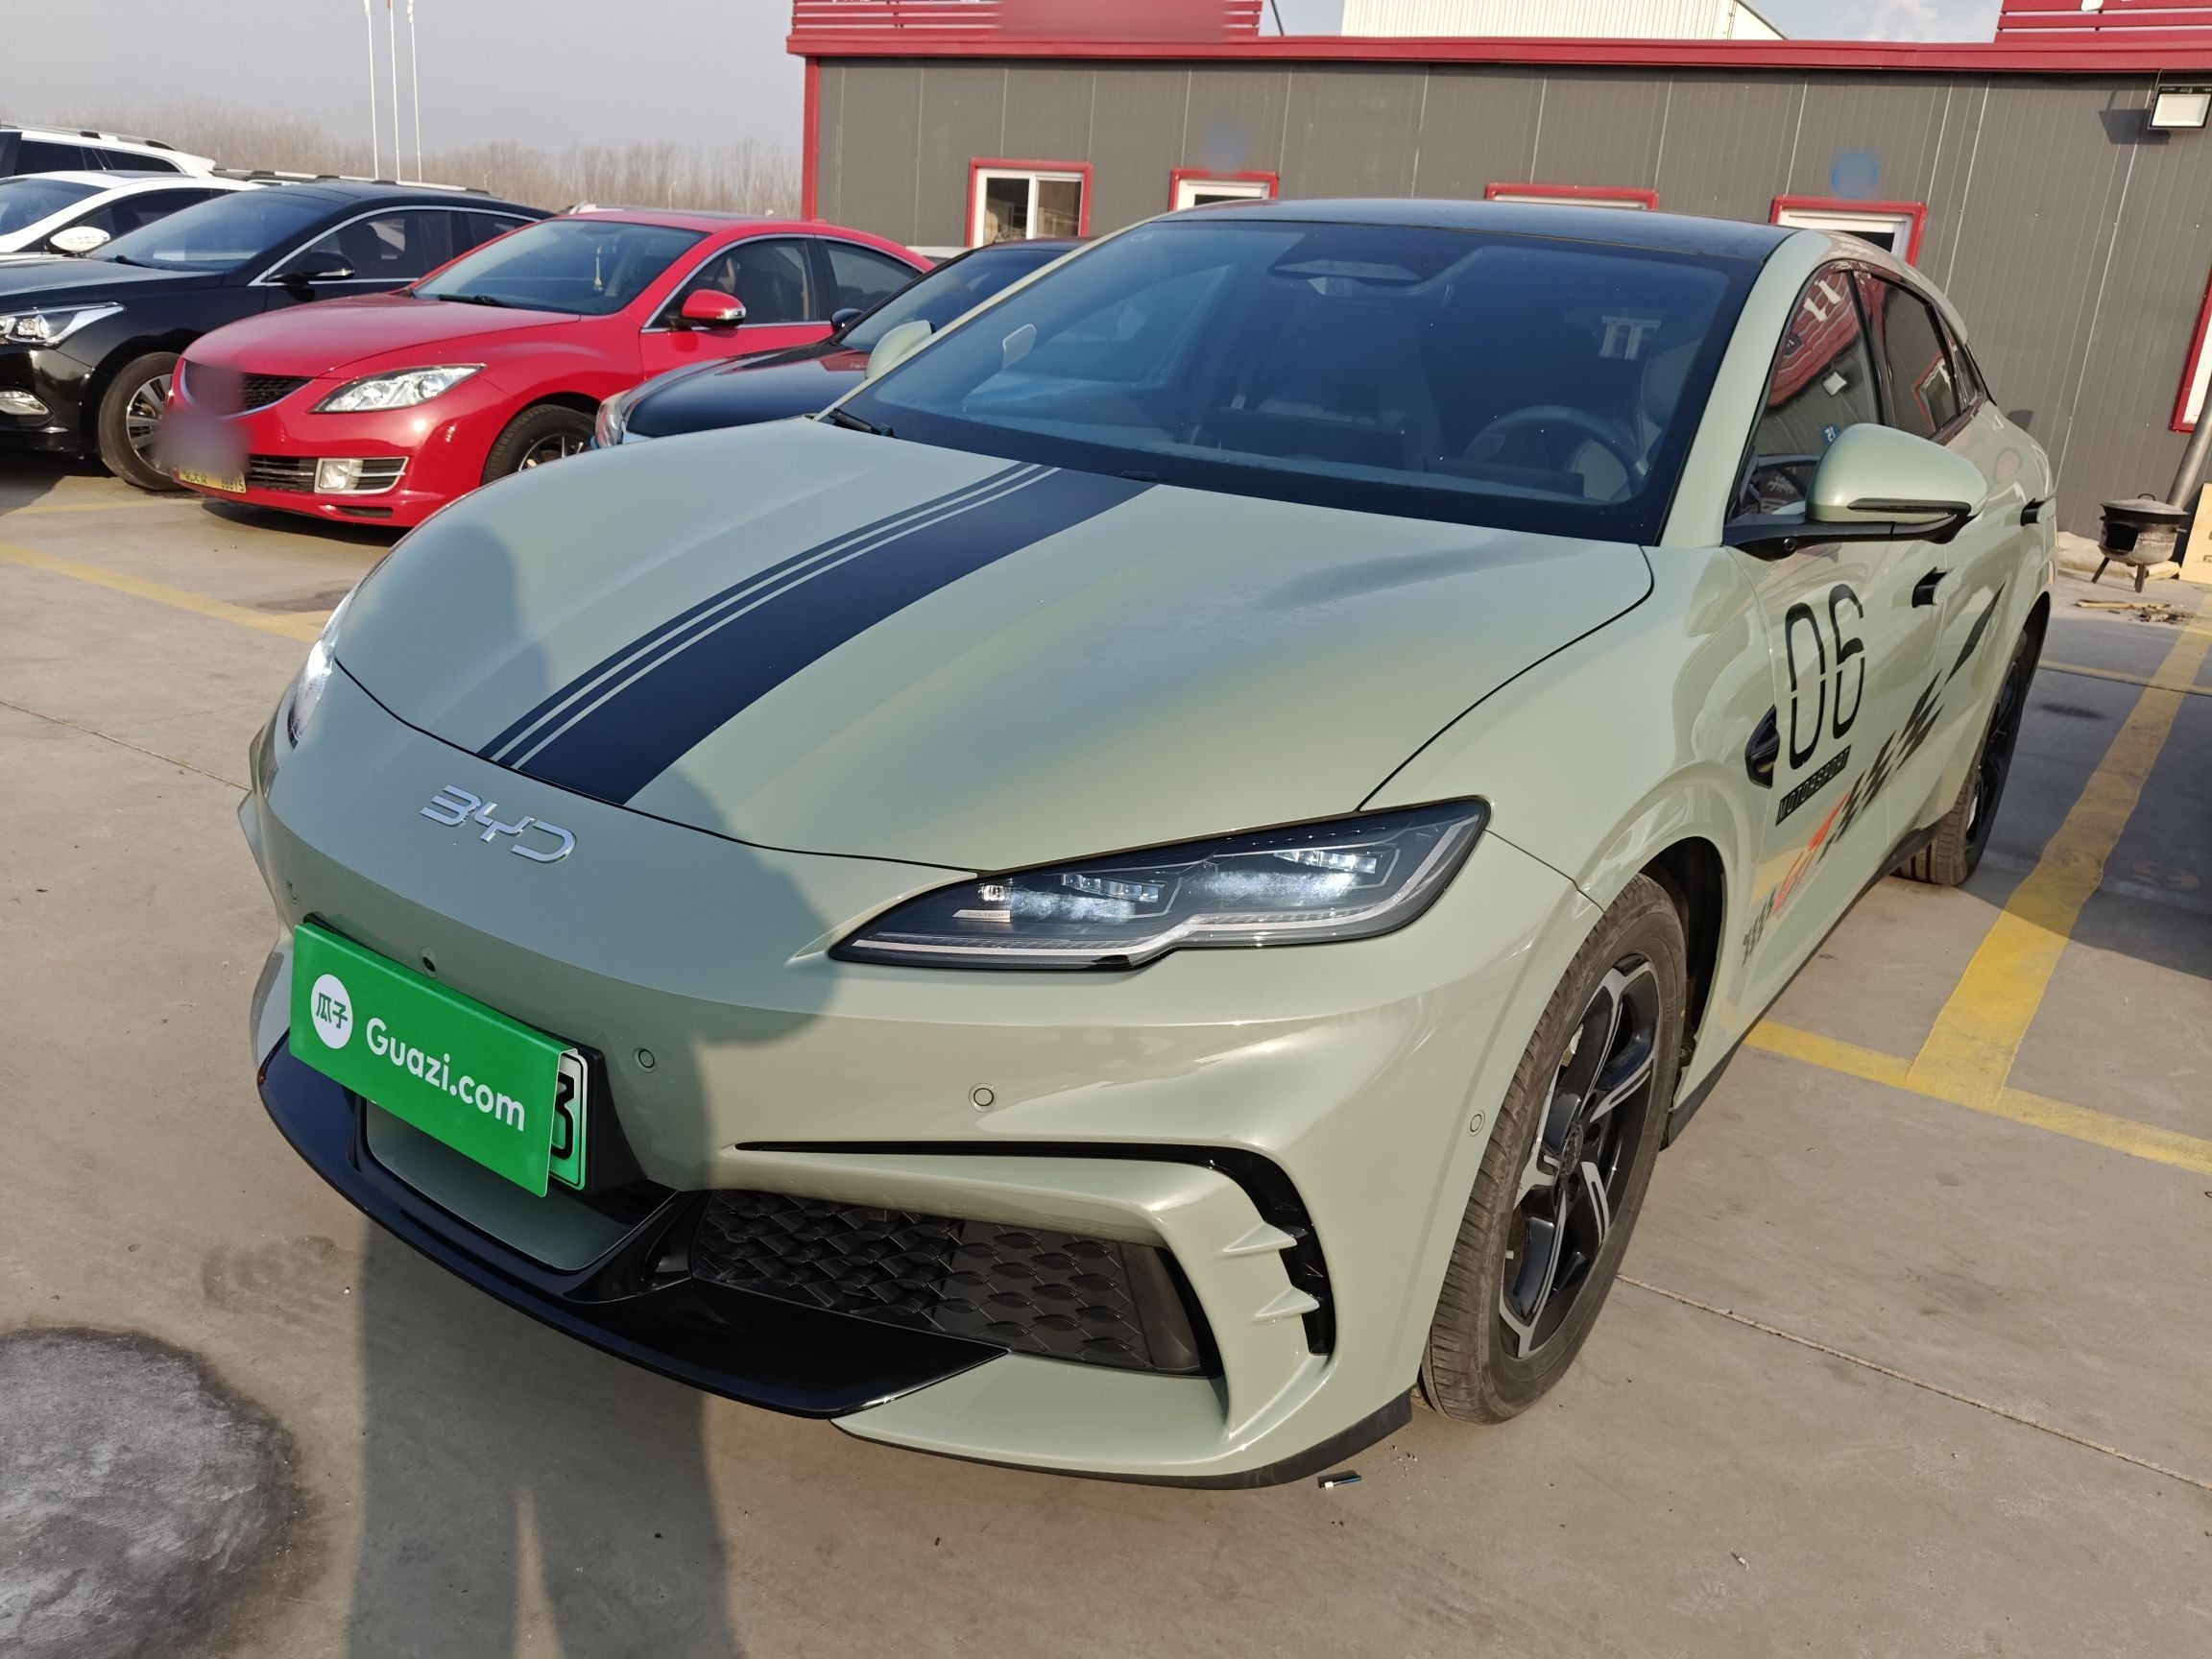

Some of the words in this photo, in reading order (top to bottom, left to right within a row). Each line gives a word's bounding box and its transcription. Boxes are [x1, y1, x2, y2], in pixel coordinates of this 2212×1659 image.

[1785, 584, 1865, 770] 06
[420, 784, 577, 864] BYD
[316, 992, 349, 1029] 瓜子
[366, 1017, 525, 1132] Guazi.com
